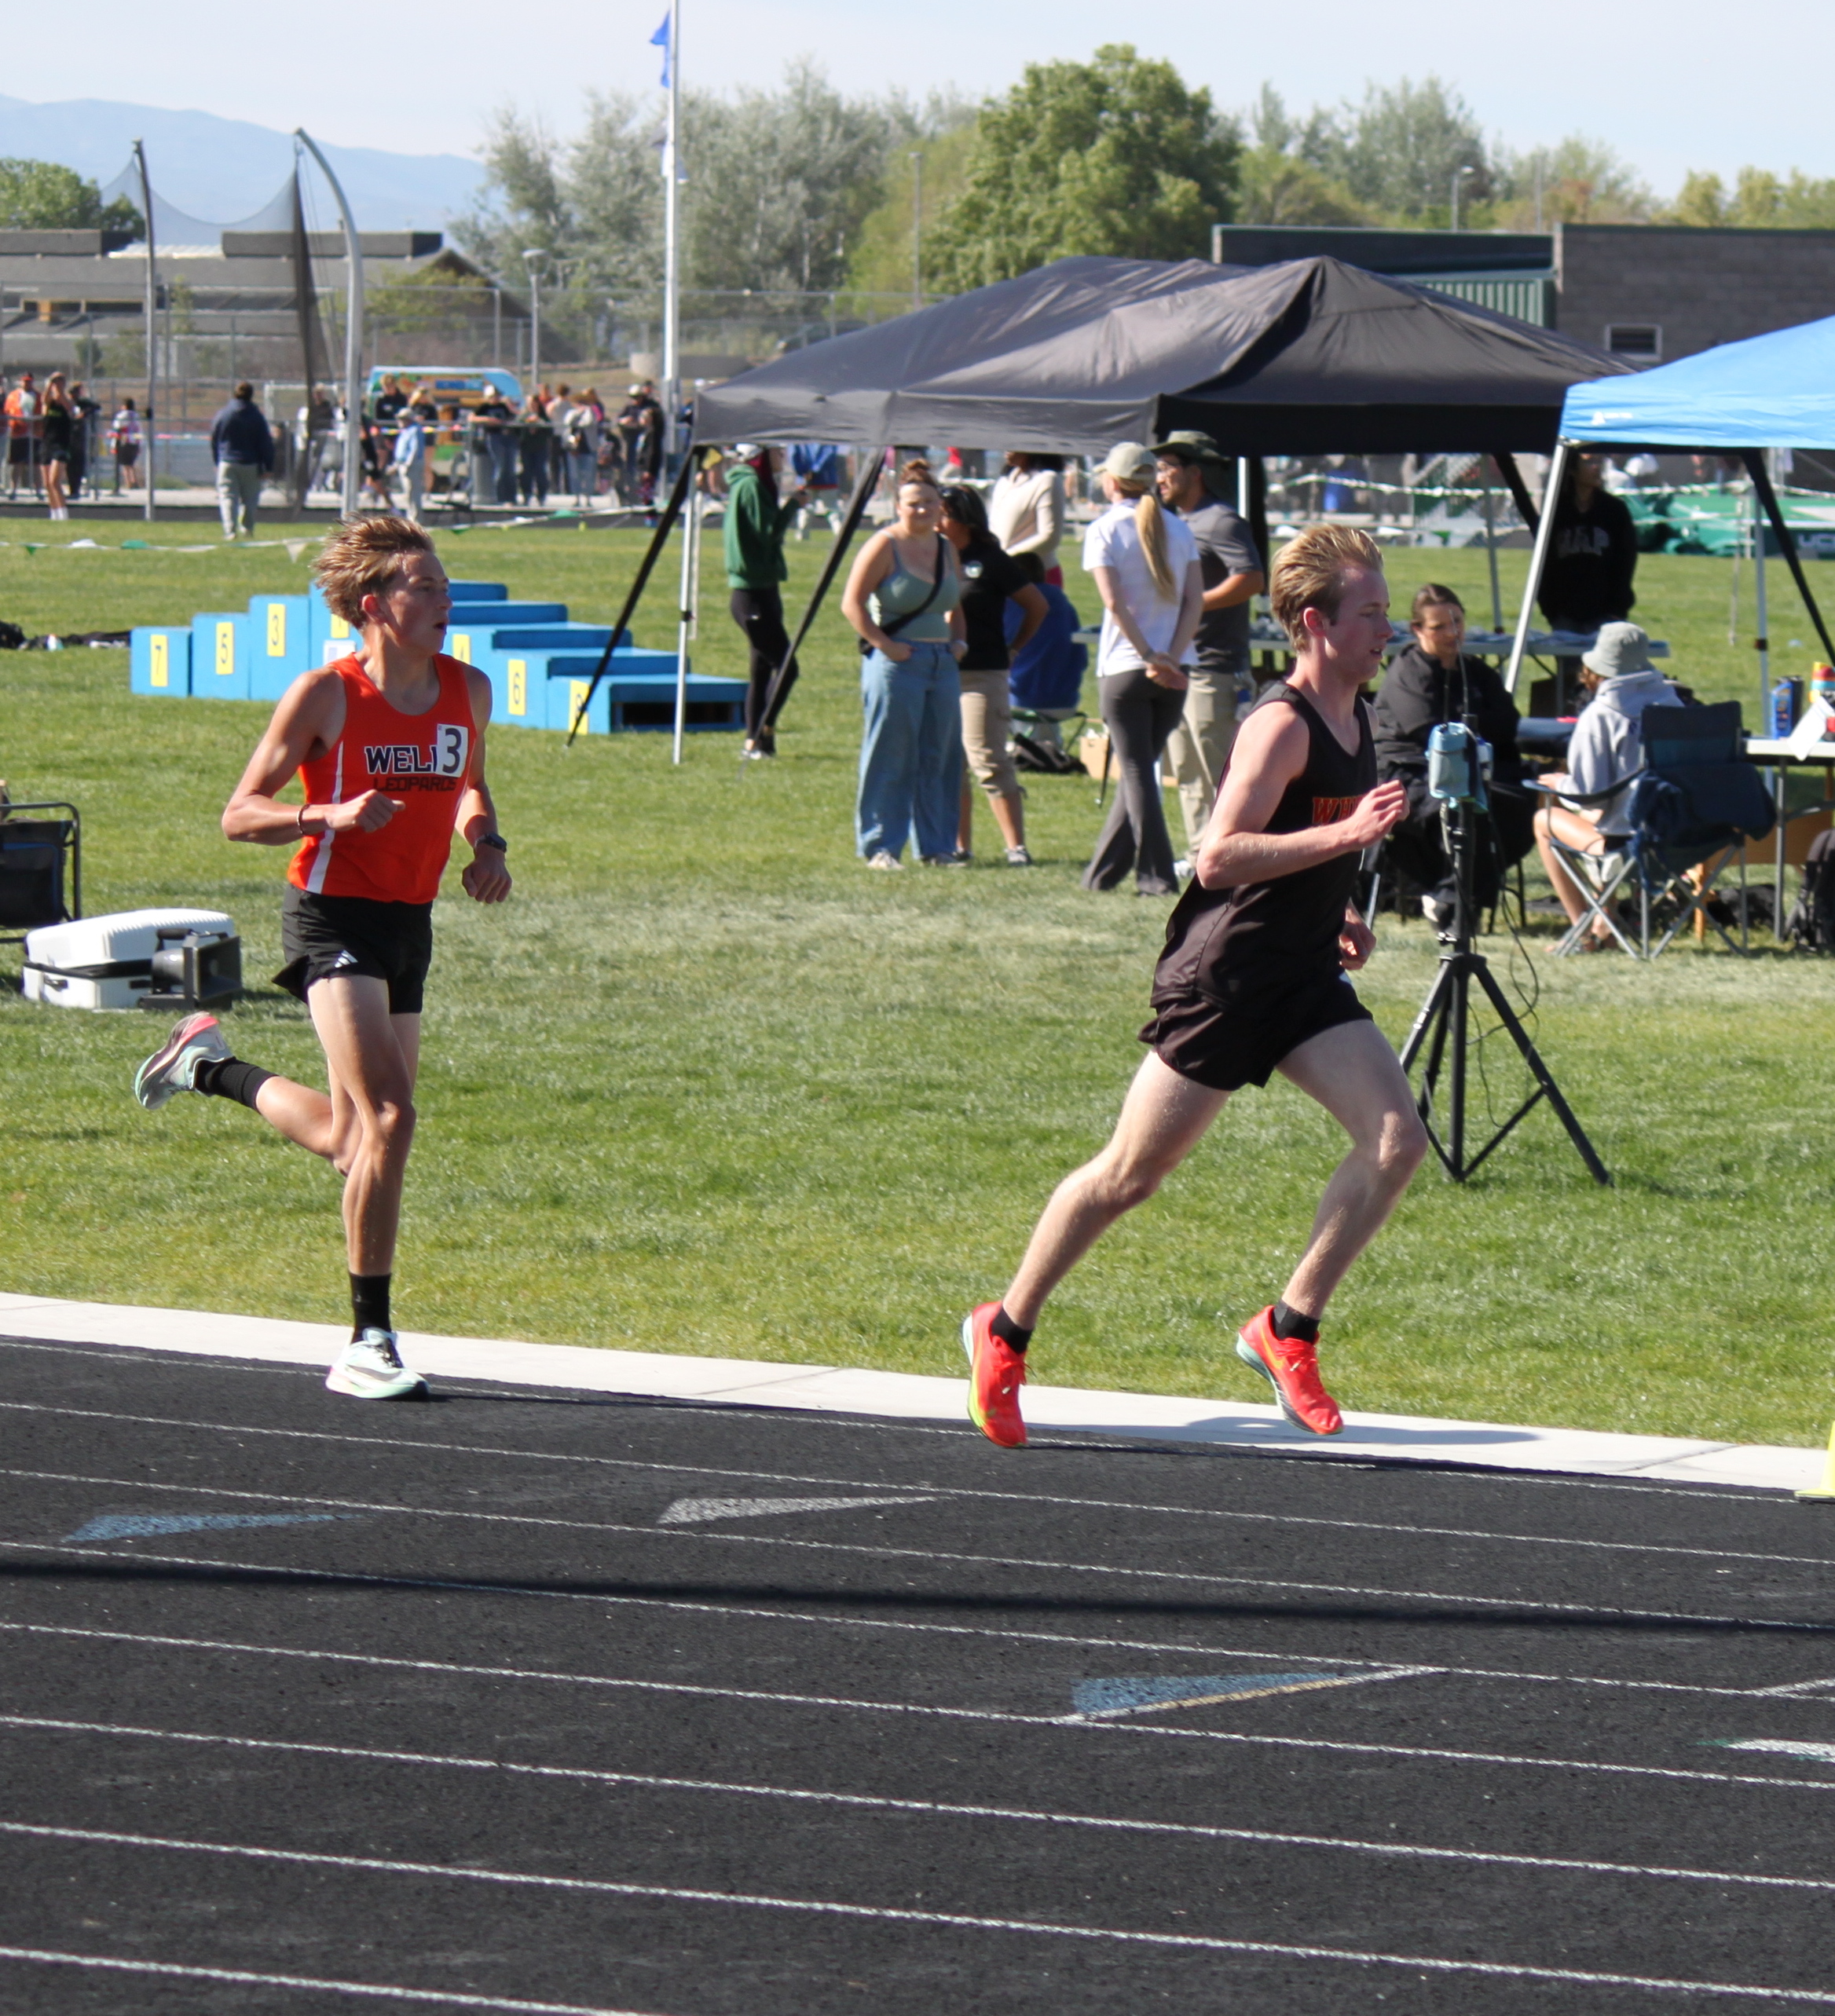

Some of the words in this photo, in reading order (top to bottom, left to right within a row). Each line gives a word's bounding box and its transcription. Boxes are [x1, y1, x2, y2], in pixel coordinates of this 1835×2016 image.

[271, 613, 280, 646] 3
[155, 644, 163, 675] 7
[221, 632, 229, 664] 5
[512, 671, 522, 705] 6
[442, 727, 462, 774] 3
